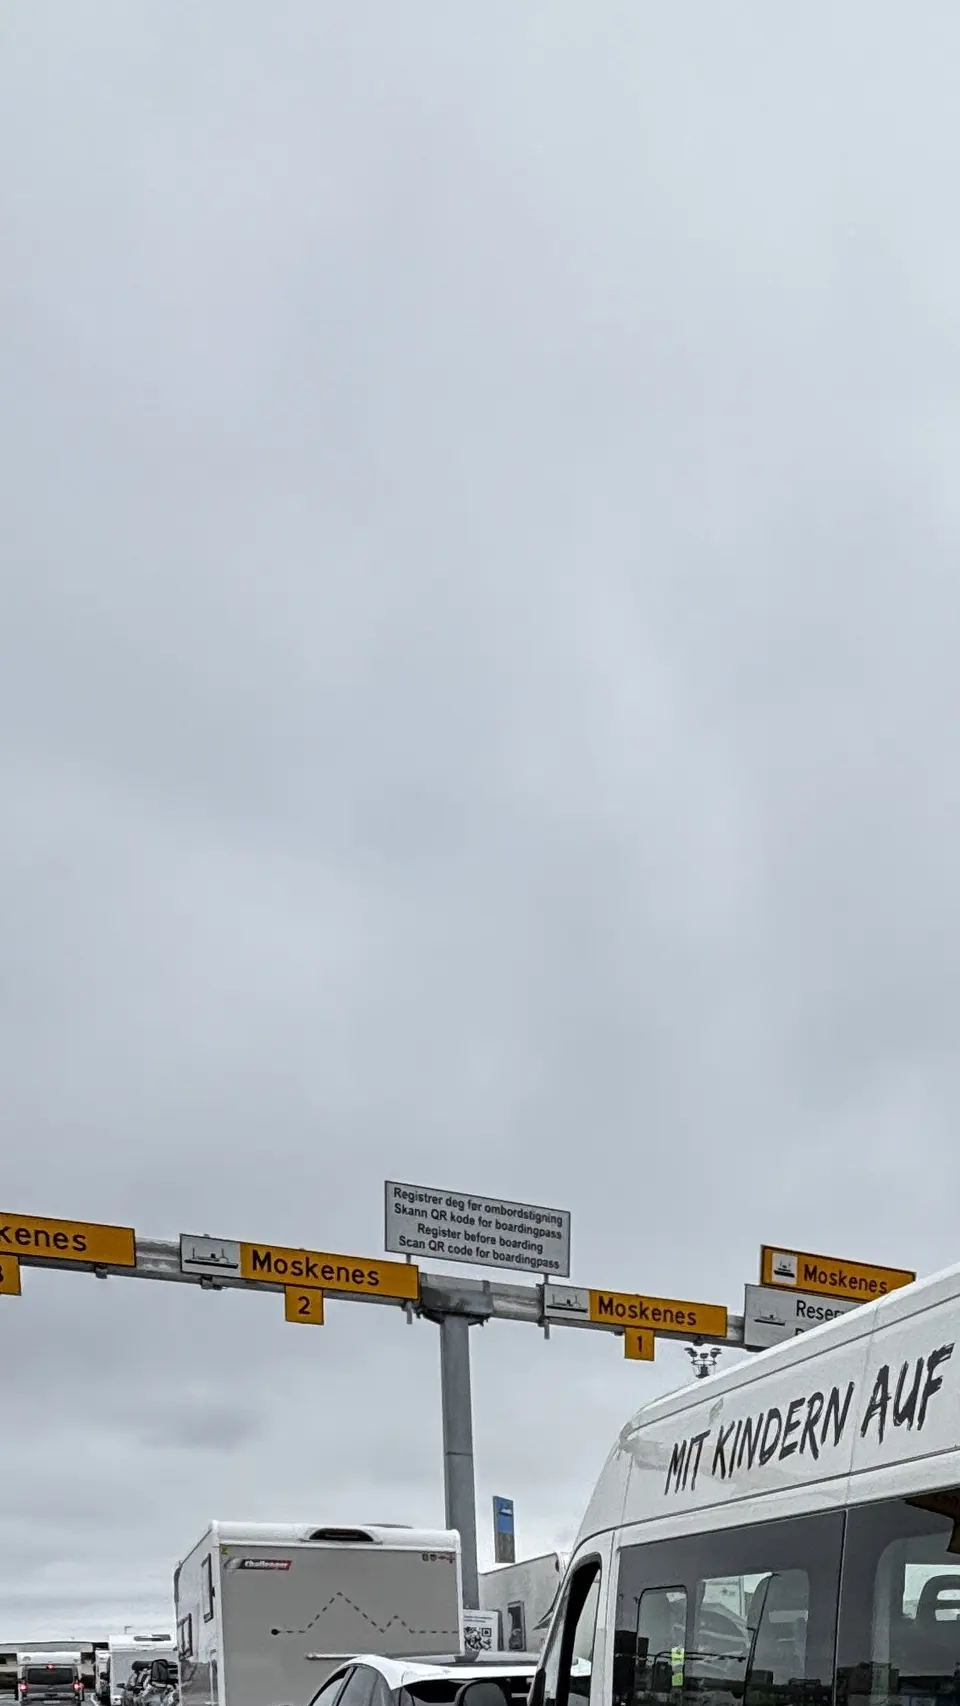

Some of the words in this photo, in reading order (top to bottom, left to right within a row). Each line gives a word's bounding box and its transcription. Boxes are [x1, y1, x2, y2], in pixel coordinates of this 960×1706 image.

[393, 1187, 444, 1206] Registrer
[445, 1198, 465, 1211] deg
[484, 1204, 563, 1228] ombordstigning
[394, 1203, 428, 1219] Skann
[430, 1209, 448, 1222] QR
[450, 1213, 476, 1226] kode
[478, 1217, 492, 1228] for
[495, 1219, 562, 1240] boardingpass
[399, 1236, 426, 1249] Scan
[428, 1240, 445, 1252] QR
[447, 1243, 473, 1256] code
[475, 1247, 490, 1259] for
[492, 1249, 560, 1270] boardingpass
[417, 1223, 462, 1240] Register
[464, 1229, 496, 1245] before
[499, 1234, 543, 1254] boarding
[252, 1249, 380, 1286] Moskenes
[803, 1264, 888, 1294] Moskenes
[297, 1296, 312, 1315] 2
[598, 1295, 697, 1326] Moskenes
[796, 1299, 845, 1321] Reser
[636, 1335, 643, 1353] 1
[664, 1429, 712, 1495] MIT
[711, 1381, 855, 1480] KINDERN
[860, 1342, 956, 1445] AUF
